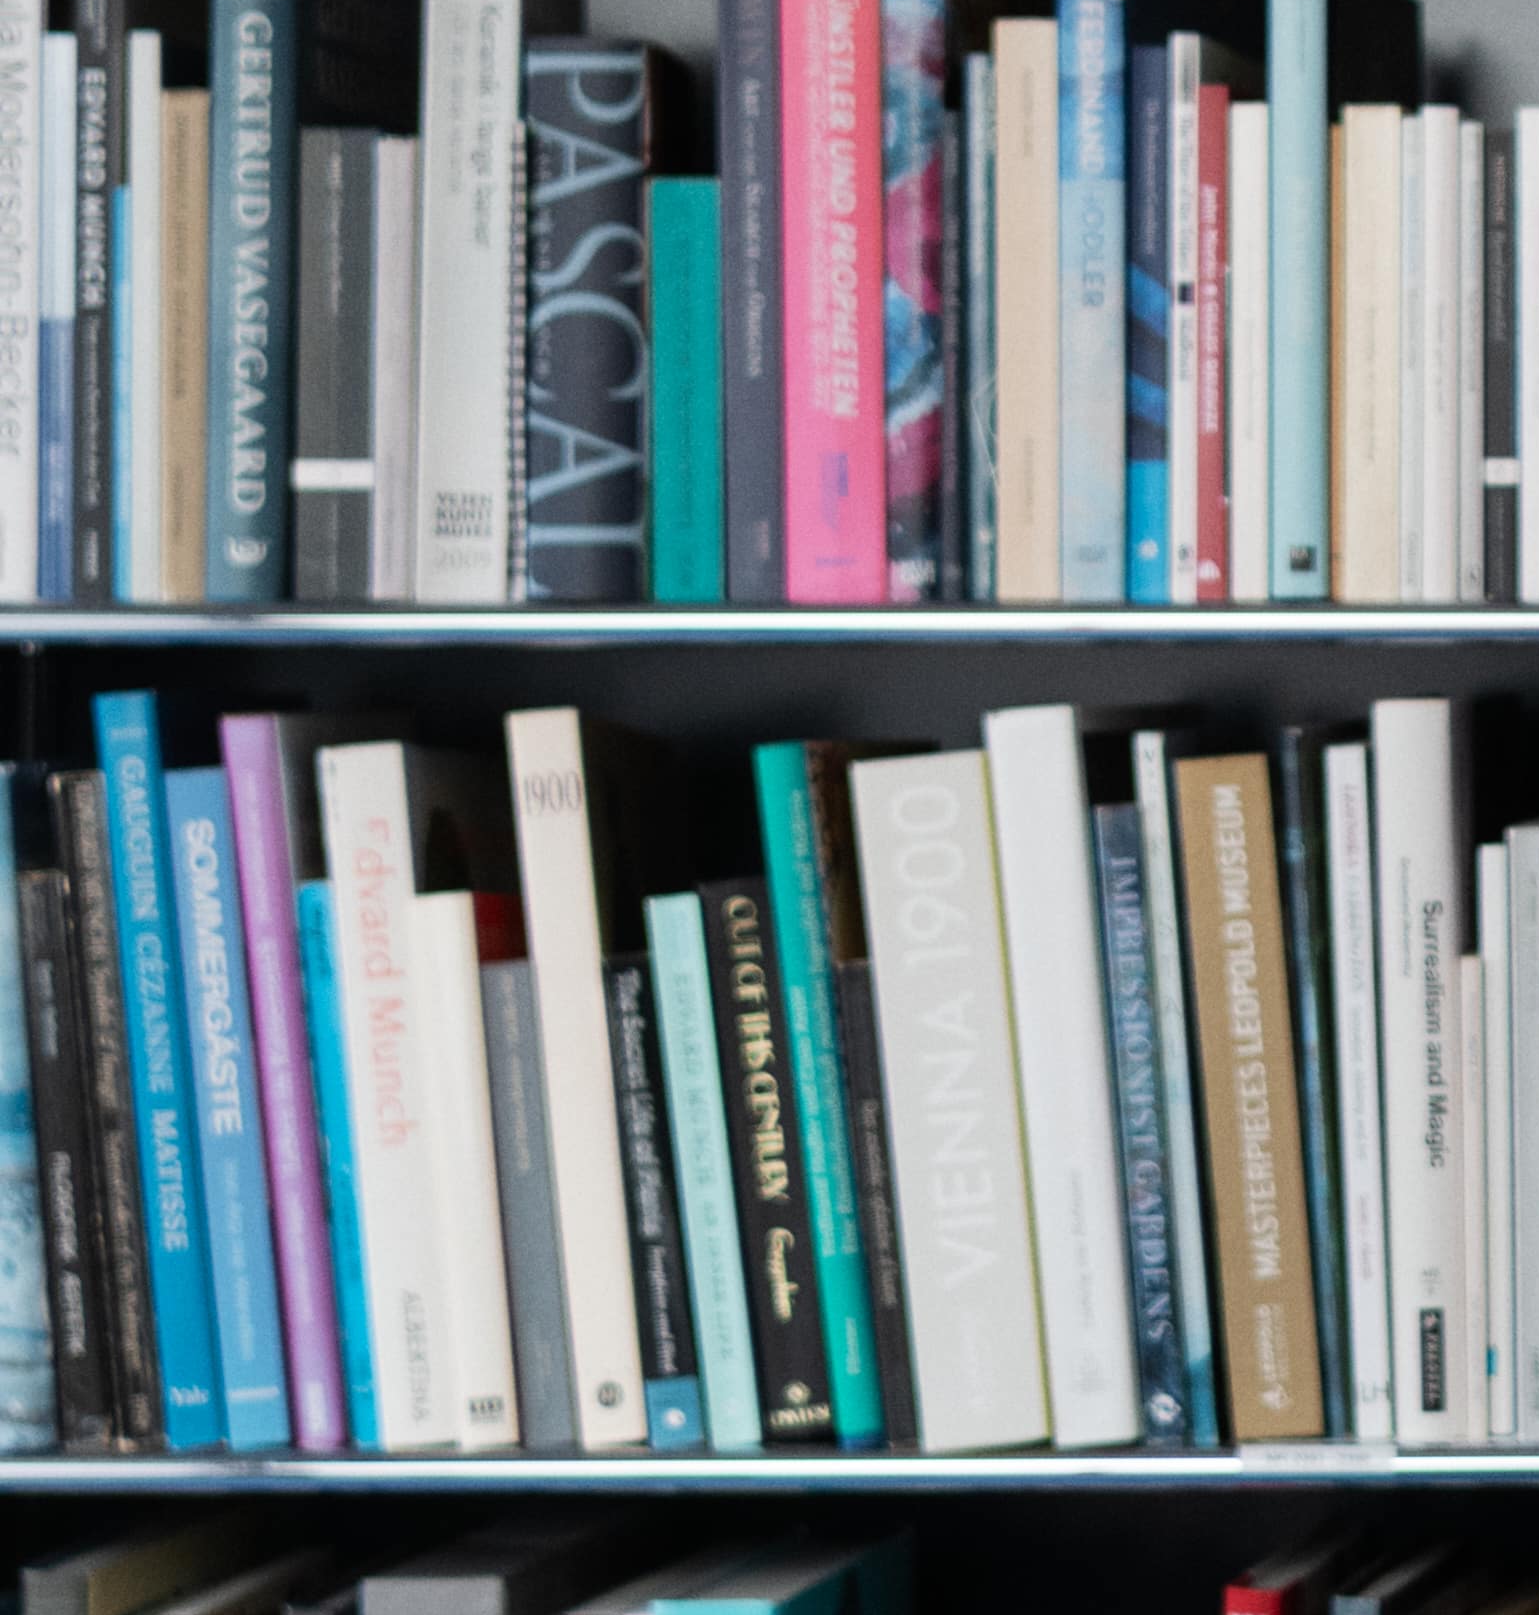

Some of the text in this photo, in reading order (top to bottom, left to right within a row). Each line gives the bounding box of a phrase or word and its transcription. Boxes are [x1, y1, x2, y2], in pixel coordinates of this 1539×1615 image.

[1079, 1, 1104, 173] FERDINAND
[232, 12, 271, 512] GERTRUD VASEGAARD
[527, 51, 644, 598] PASCAL
[184, 819, 242, 1135] SOMMERGÄSTE
[1421, 900, 1449, 1168] Surrealism and Magic
